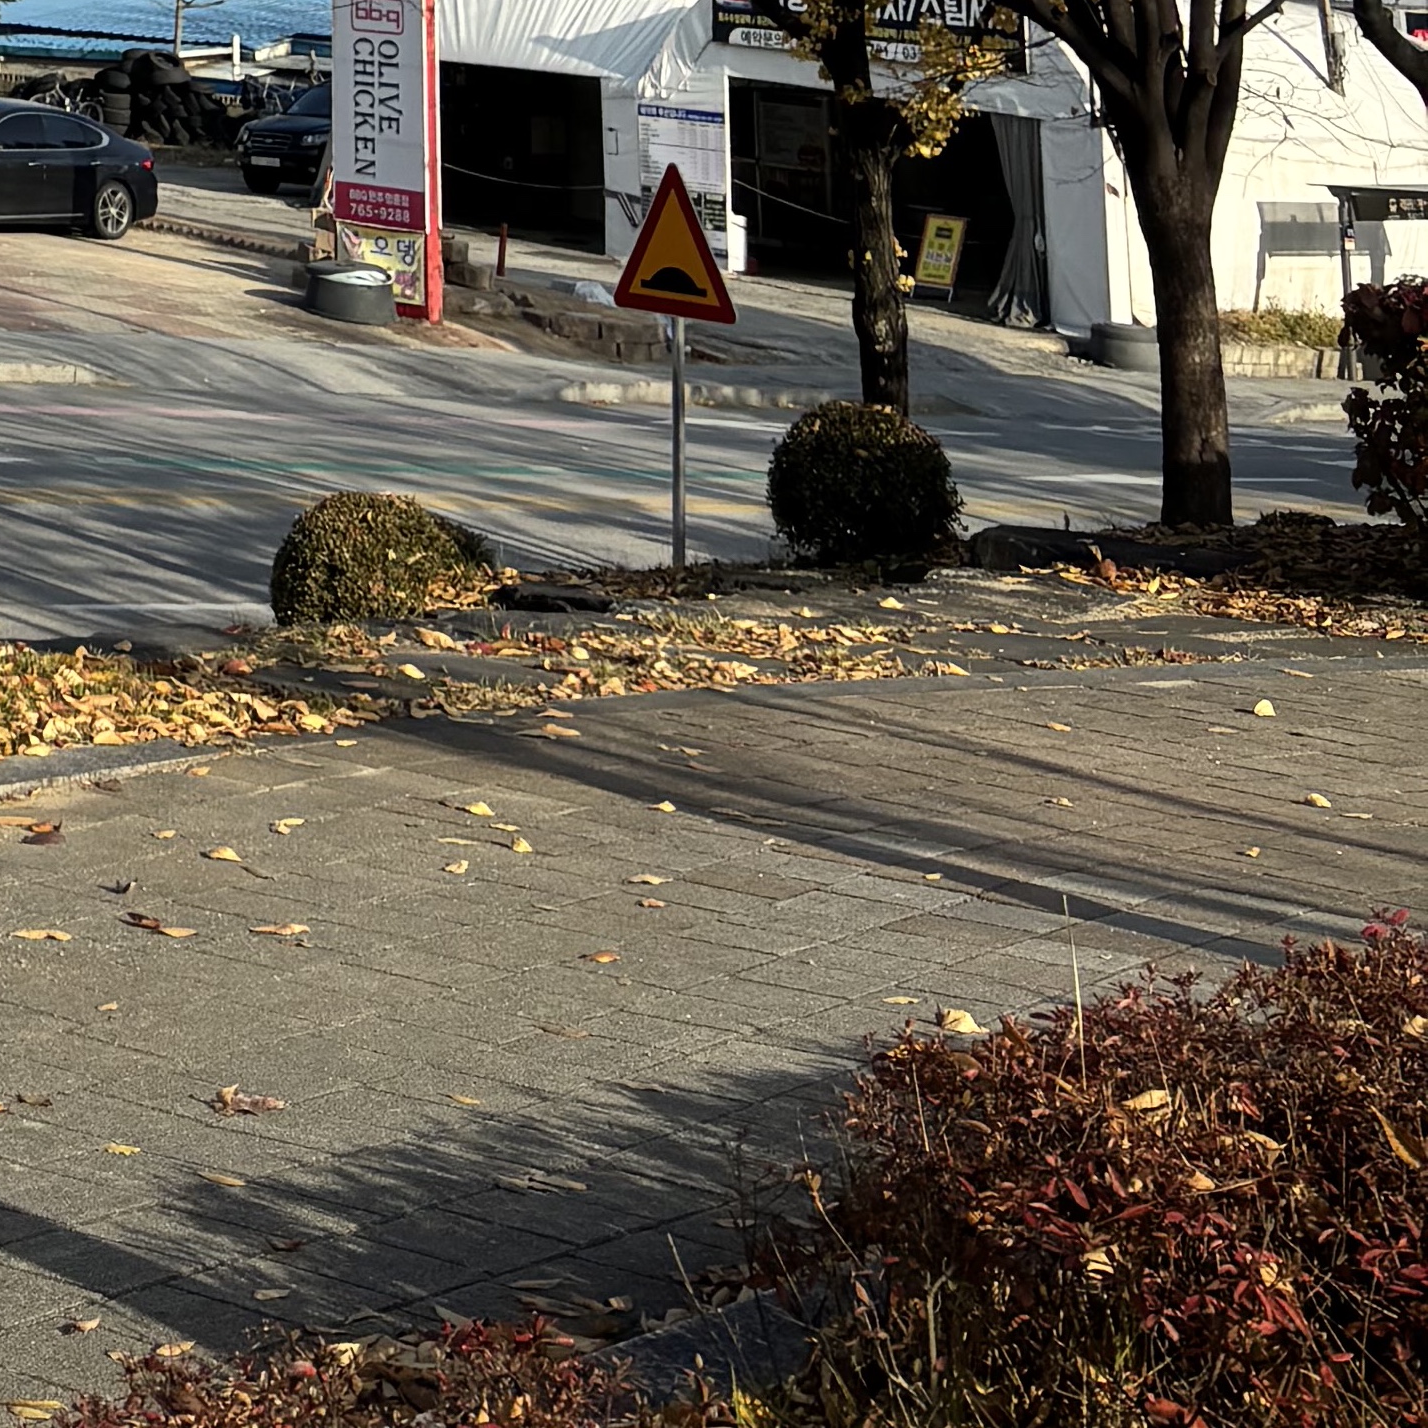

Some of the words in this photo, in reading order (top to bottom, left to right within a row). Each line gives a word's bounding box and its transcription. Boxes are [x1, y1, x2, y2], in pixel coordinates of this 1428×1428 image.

[352, 36, 376, 179] CHICKEN
[377, 38, 404, 137] OLIVE
[370, 236, 416, 266] 오뎅
